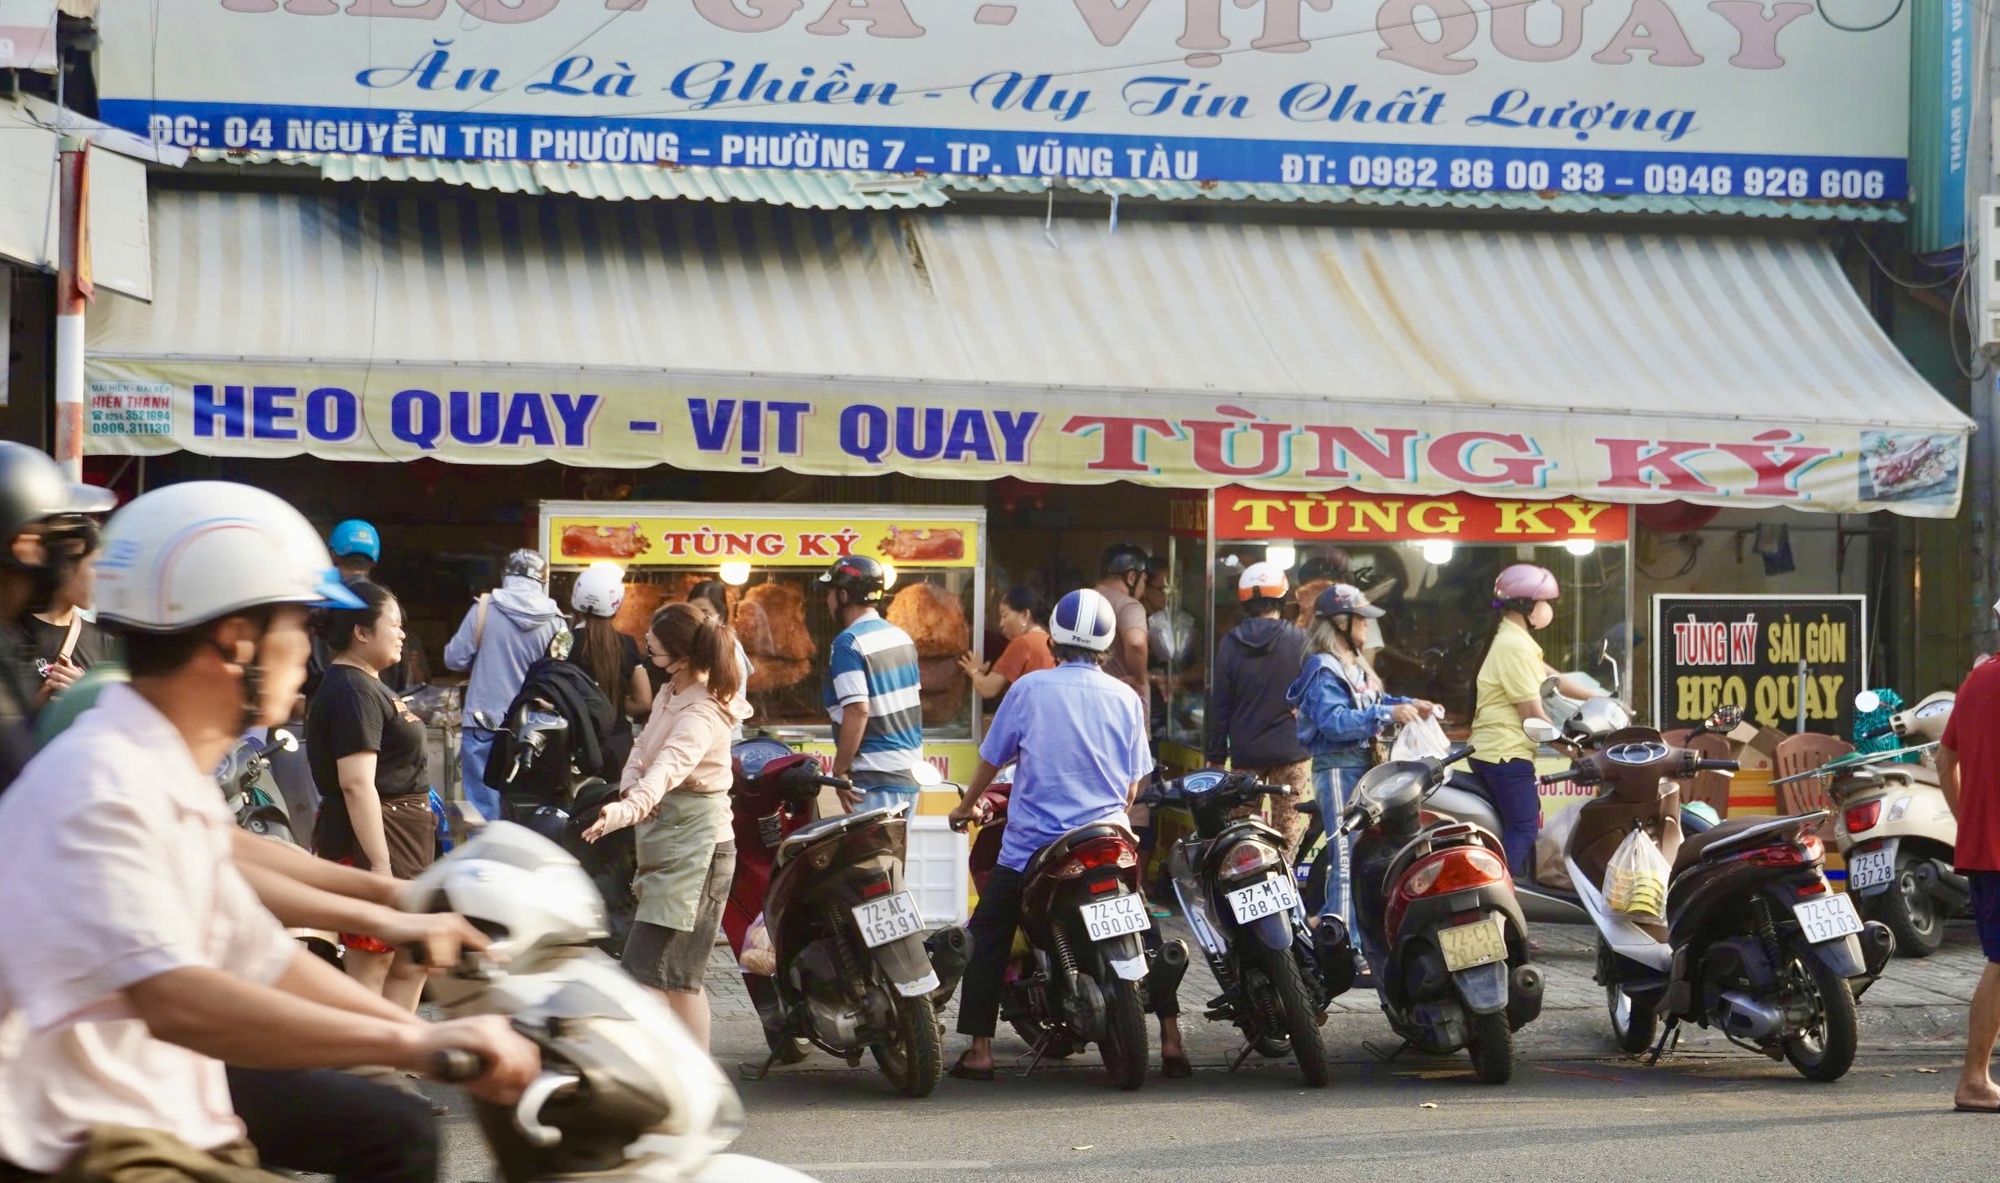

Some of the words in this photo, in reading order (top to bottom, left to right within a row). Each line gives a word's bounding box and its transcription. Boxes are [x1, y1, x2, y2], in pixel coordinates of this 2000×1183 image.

[1376, 0, 1814, 75] QUAY
[1951, 38, 1962, 100] QUAN
[355, 38, 506, 92] Ăn
[525, 56, 642, 98] Là
[662, 60, 908, 111] Ghiền
[970, 71, 1096, 122] Uy
[1122, 76, 1256, 119] Tín
[1279, 82, 1448, 125] Chất
[1465, 87, 1700, 142] Lượng
[148, 114, 210, 148] ĐC:
[224, 117, 274, 148] 04
[287, 111, 446, 155] NGUYỄN
[460, 126, 517, 158] TRI
[531, 127, 679, 163] PHƯƠNG
[722, 130, 870, 169] PHƯỜNG
[882, 140, 905, 170] 7
[947, 142, 1001, 173] TP.
[1016, 139, 1113, 177] VŨNG
[1126, 143, 1198, 179] TÀU
[1950, 107, 1962, 174] THAM
[1281, 154, 1336, 184] ĐT:
[1350, 156, 1438, 187] 0982
[1450, 158, 1494, 188] 86
[1505, 160, 1549, 190] 00
[1561, 162, 1604, 193] 33
[1644, 164, 1732, 195] 0946
[1744, 167, 1808, 197] 926
[1820, 169, 1884, 199] 606
[193, 385, 359, 442] HEO
[391, 389, 602, 450] QUAY
[687, 398, 811, 465] VỊT
[840, 404, 1041, 465] QUAY
[1061, 405, 1548, 486] TÙNG
[1594, 428, 1834, 498] KÝ
[1232, 492, 1465, 534] TÙNG
[664, 527, 785, 556] TÙNG
[798, 528, 859, 557] KÝ
[1673, 613, 1727, 666] TÙNG
[1730, 612, 1759, 666] KÝ
[1767, 613, 1800, 664] SÀI
[1805, 613, 1846, 664] GÒN
[1754, 674, 1845, 729] QUAY
[1853, 866, 1891, 888] 037.28
[1856, 852, 1886, 872] 72-C1
[862, 896, 906, 924] 72-AC
[1090, 898, 1133, 920] 72-C2
[1238, 880, 1281, 905] 37-M1
[1239, 893, 1291, 921] 788.16
[1803, 898, 1844, 921] 72-C2
[866, 912, 920, 943] 153.91
[1091, 913, 1145, 938] 090.05
[1807, 914, 1858, 940] 137.03
